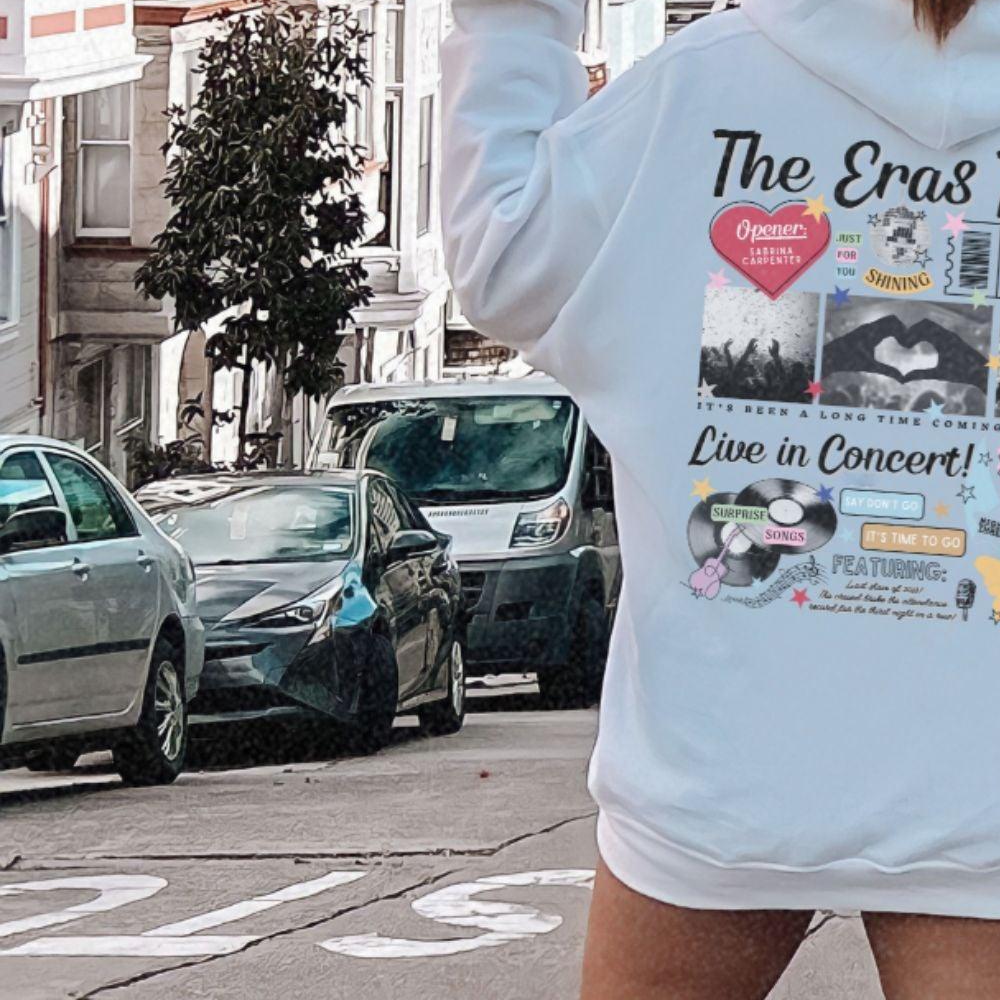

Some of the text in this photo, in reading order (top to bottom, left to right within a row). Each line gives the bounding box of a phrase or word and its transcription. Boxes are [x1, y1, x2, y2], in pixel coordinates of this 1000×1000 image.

[713, 129, 815, 197] The
[834, 140, 977, 209] Eras
[736, 219, 807, 243] Opener:
[837, 234, 862, 243] JUST
[750, 247, 793, 256] SABRINA
[837, 250, 857, 260] FOR
[742, 255, 802, 265] CARPENTER
[837, 267, 856, 276] YOU
[865, 268, 931, 291] SHINING
[697, 402, 734, 413] IT'S
[745, 405, 788, 416] BEEN
[800, 410, 808, 418] A
[820, 411, 866, 421] LONG
[877, 415, 921, 426] TIME
[688, 425, 975, 478] Live in Concert!
[902, 500, 919, 511] GO
[713, 507, 767, 521] SURPRISE
[765, 528, 804, 542] SONGS
[865, 530, 961, 548] IT'S TIME TO GO
[832, 553, 948, 582] FEATURING:
